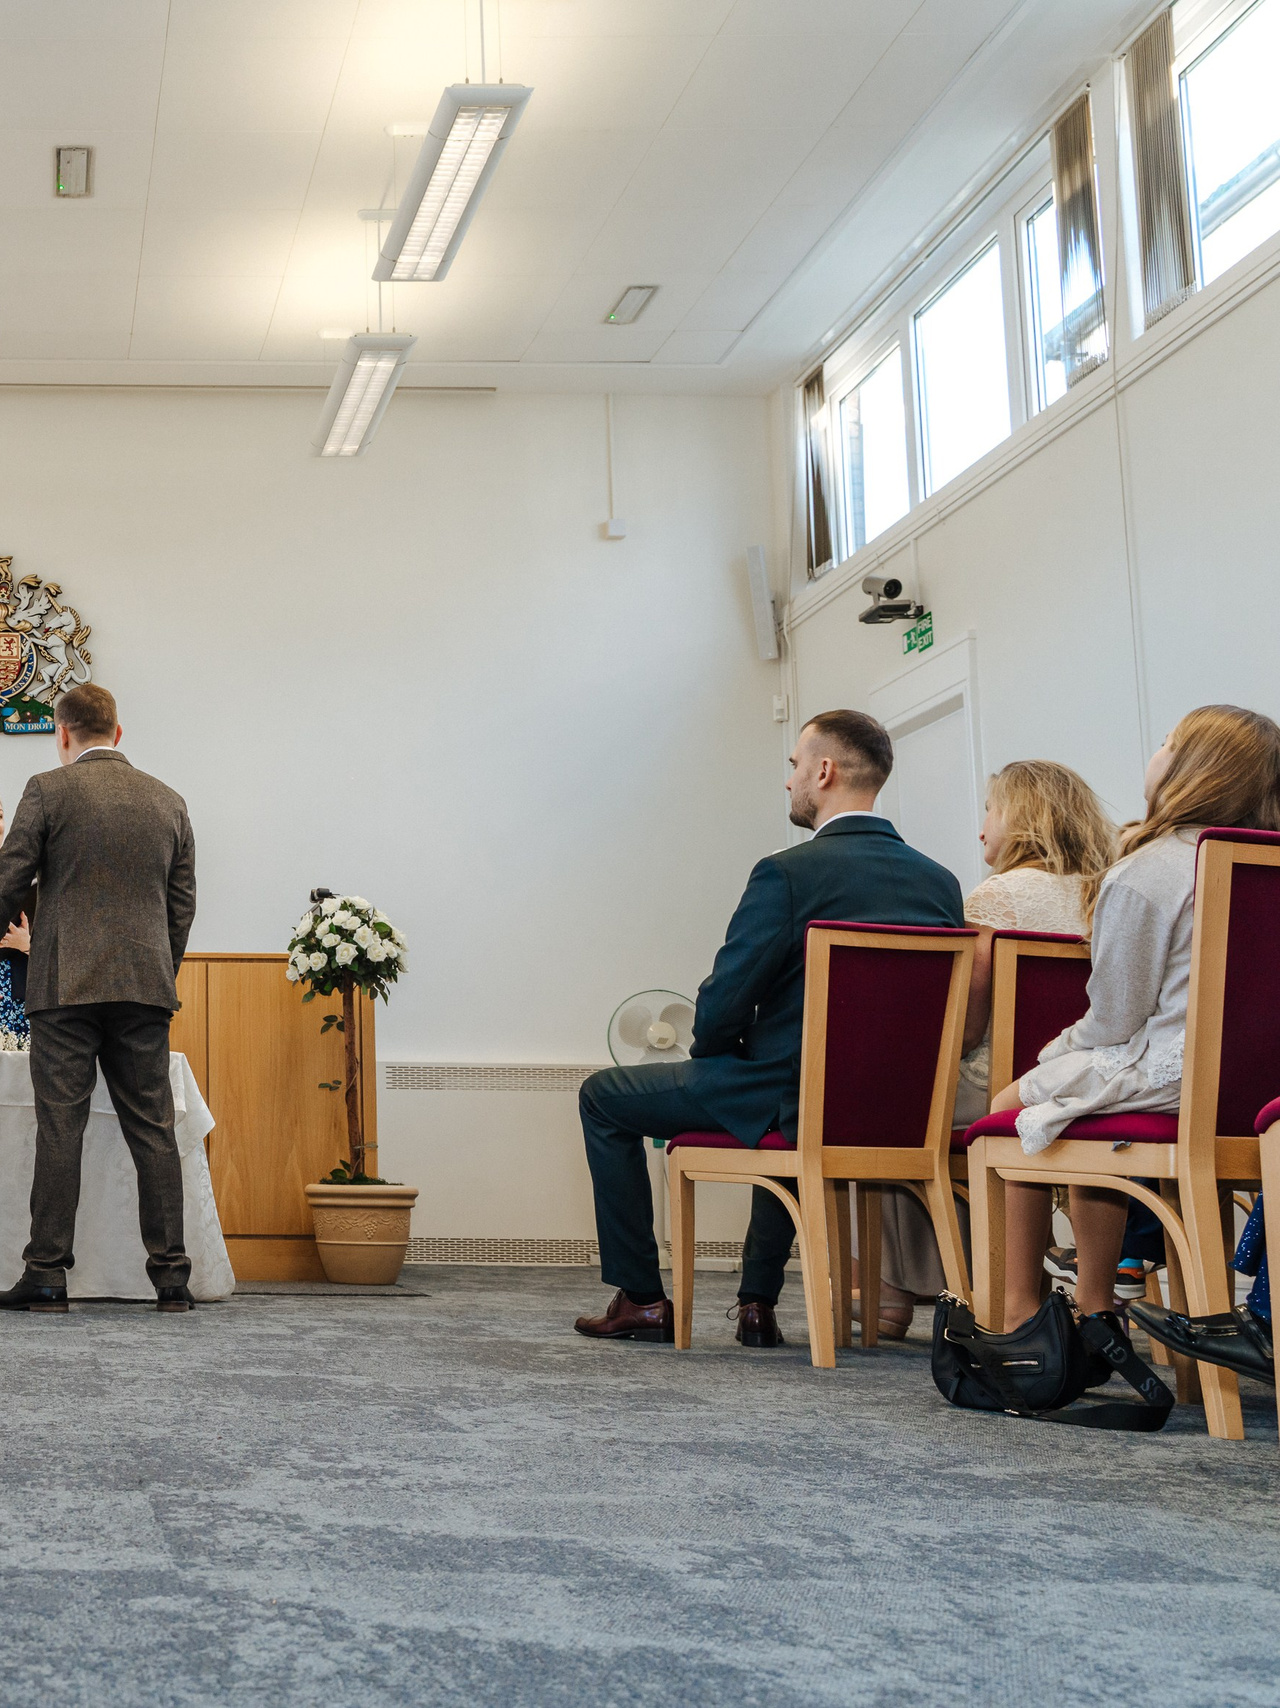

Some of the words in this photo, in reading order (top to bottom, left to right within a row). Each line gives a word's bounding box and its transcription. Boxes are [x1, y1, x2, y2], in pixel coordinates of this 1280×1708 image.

[918, 616, 932, 634] FIRE
[918, 631, 932, 649] EXIT
[5, 723, 27, 731] MON
[27, 722, 55, 731] DROIT
